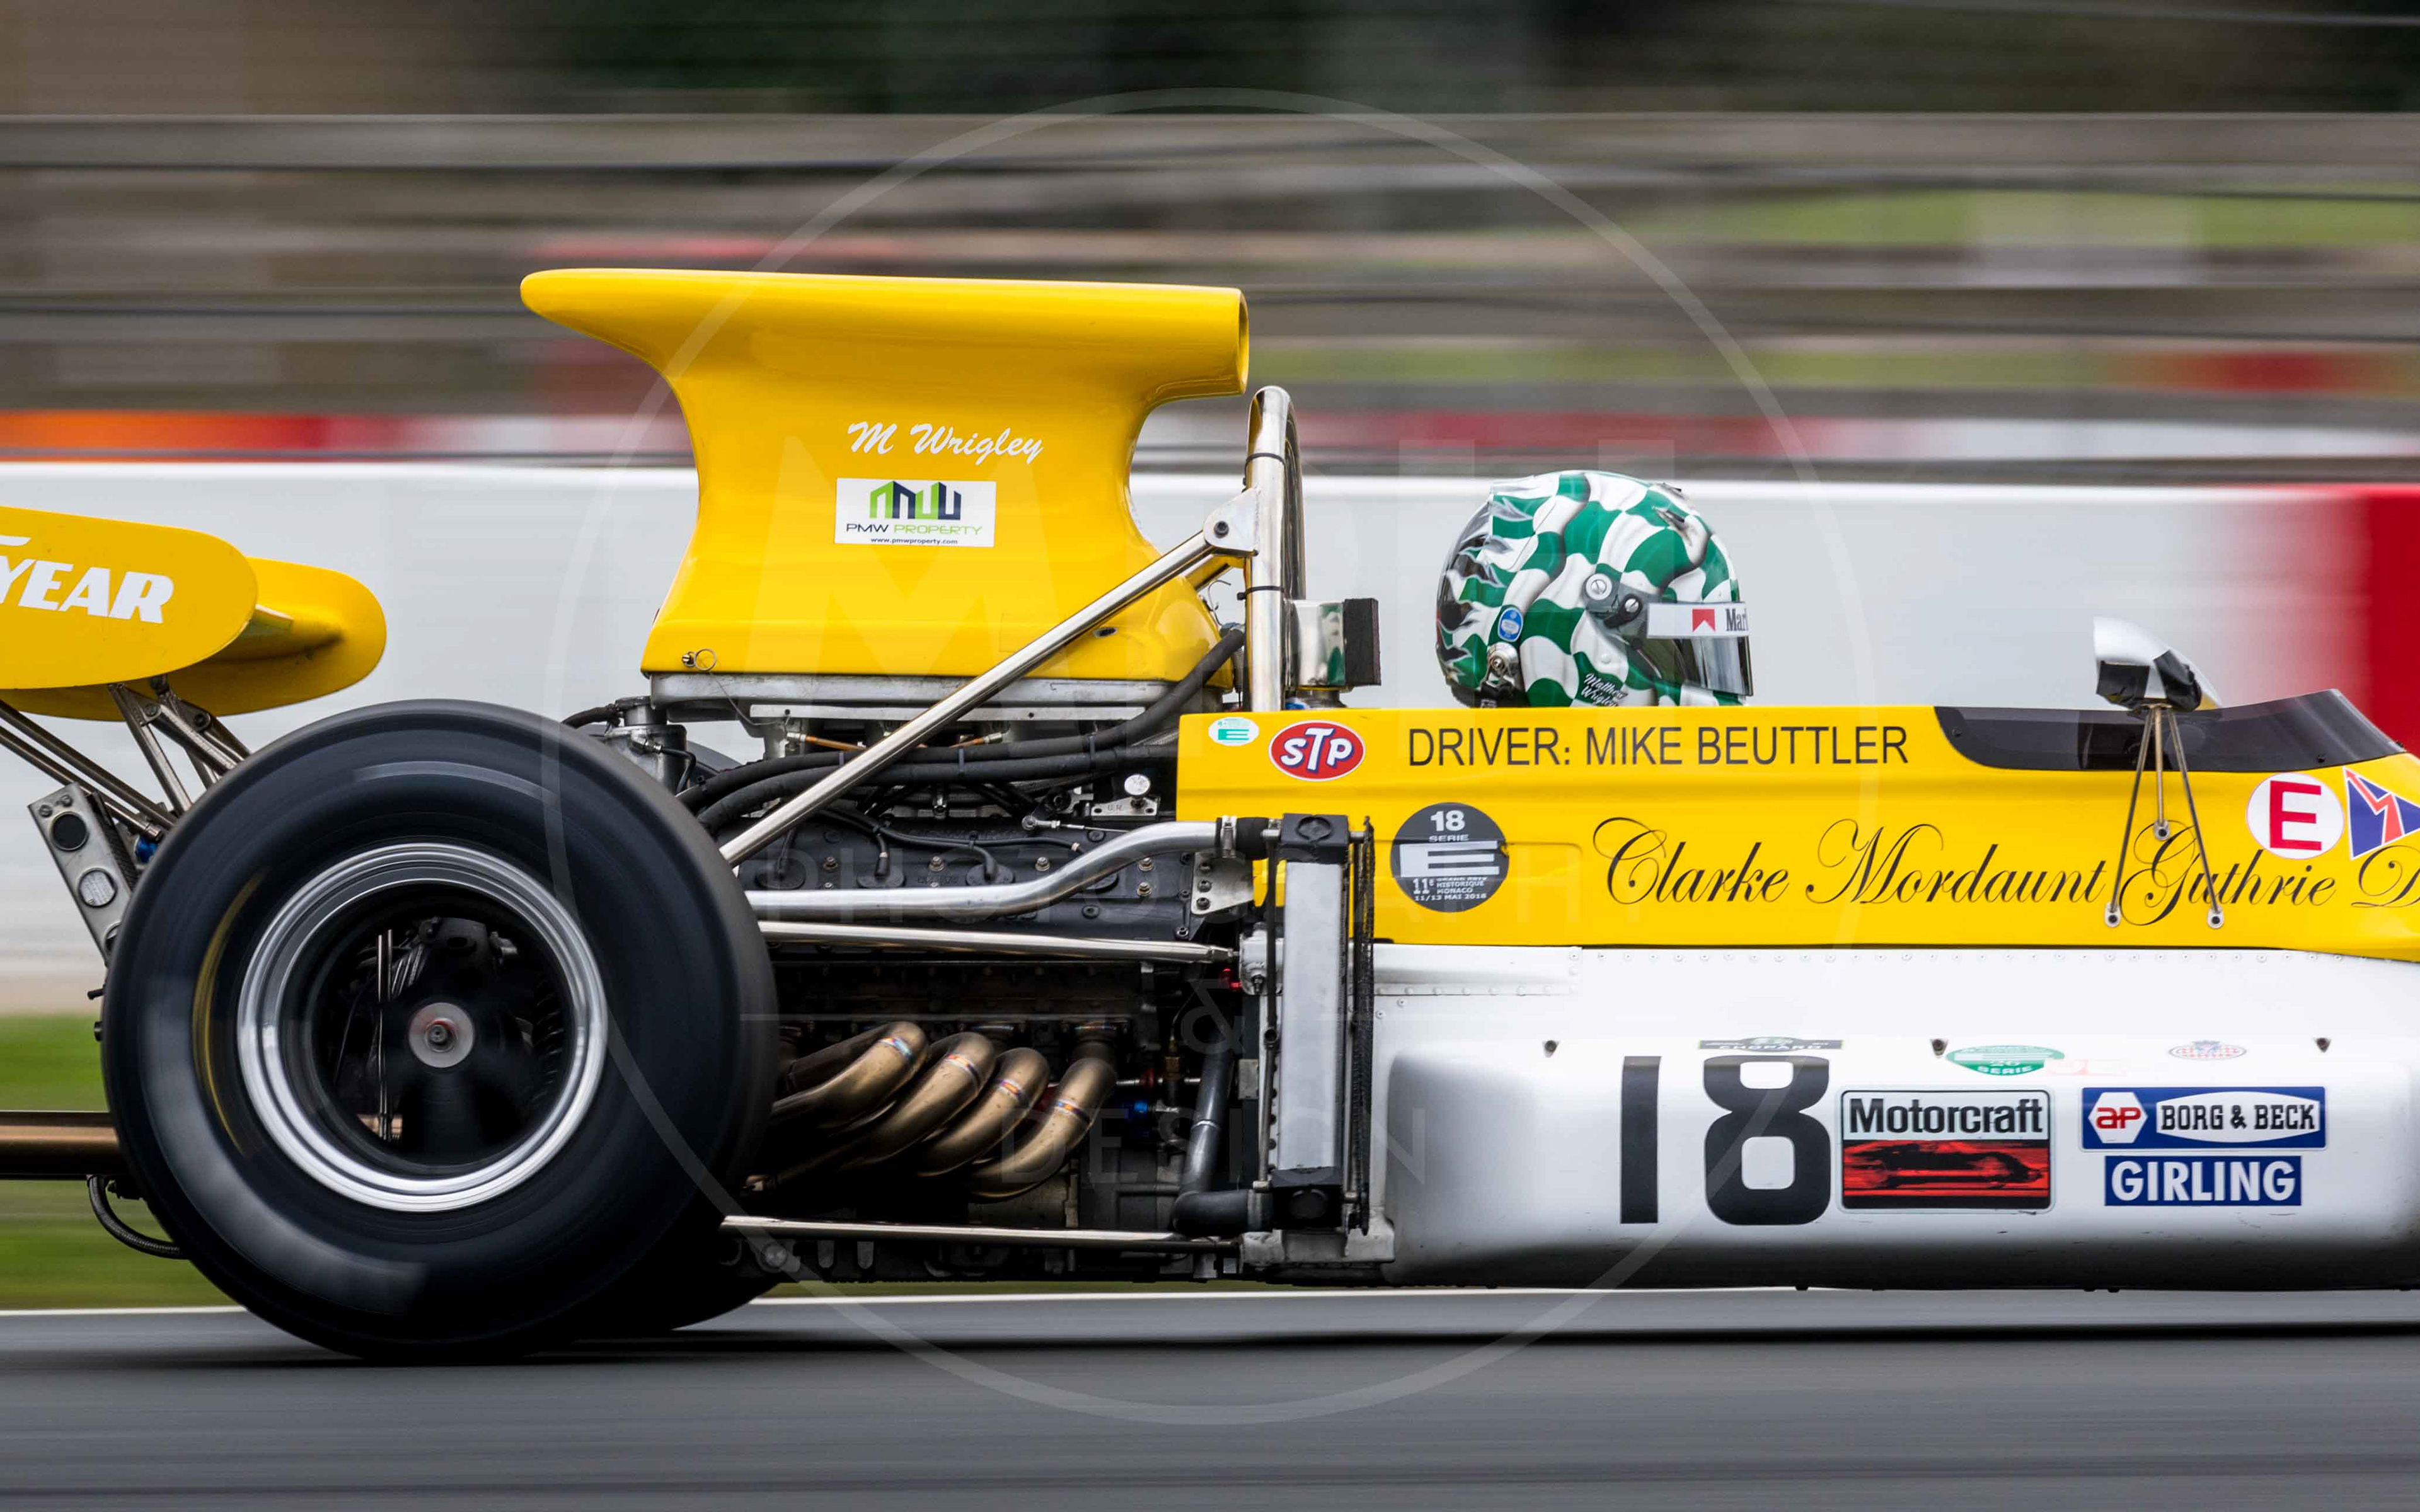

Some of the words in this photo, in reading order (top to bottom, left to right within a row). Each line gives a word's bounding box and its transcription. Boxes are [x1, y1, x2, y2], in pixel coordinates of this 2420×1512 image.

[847, 421, 897, 454] M
[910, 423, 1043, 466] Wrigley
[846, 523, 889, 534] PMW
[894, 524, 982, 536] PROPERTY
[870, 537, 958, 546] www.pmwproperty.com
[1281, 728, 1353, 771] STP
[1409, 728, 1570, 766] DRIVER:
[1586, 727, 1683, 765] MIKE
[1698, 726, 1909, 765] BEUTTLER
[1430, 810, 1466, 832] 18
[2269, 779, 2323, 851] E
[1429, 834, 1470, 842] SERIE
[1399, 840, 1500, 878] E
[1593, 816, 1790, 905] Clarke
[1805, 818, 2107, 905] Mordaunt
[2119, 819, 2337, 927] Guthrie
[1436, 880, 1485, 888] HISTORIQUE
[1850, 1098, 2043, 1135] Motorcraft
[2160, 1104, 2223, 1130] BORG
[2230, 1104, 2247, 1129] &
[2254, 1104, 2315, 1130] BECK
[1620, 1055, 1832, 1225] 18
[2111, 1160, 2296, 1201] GIRLING
